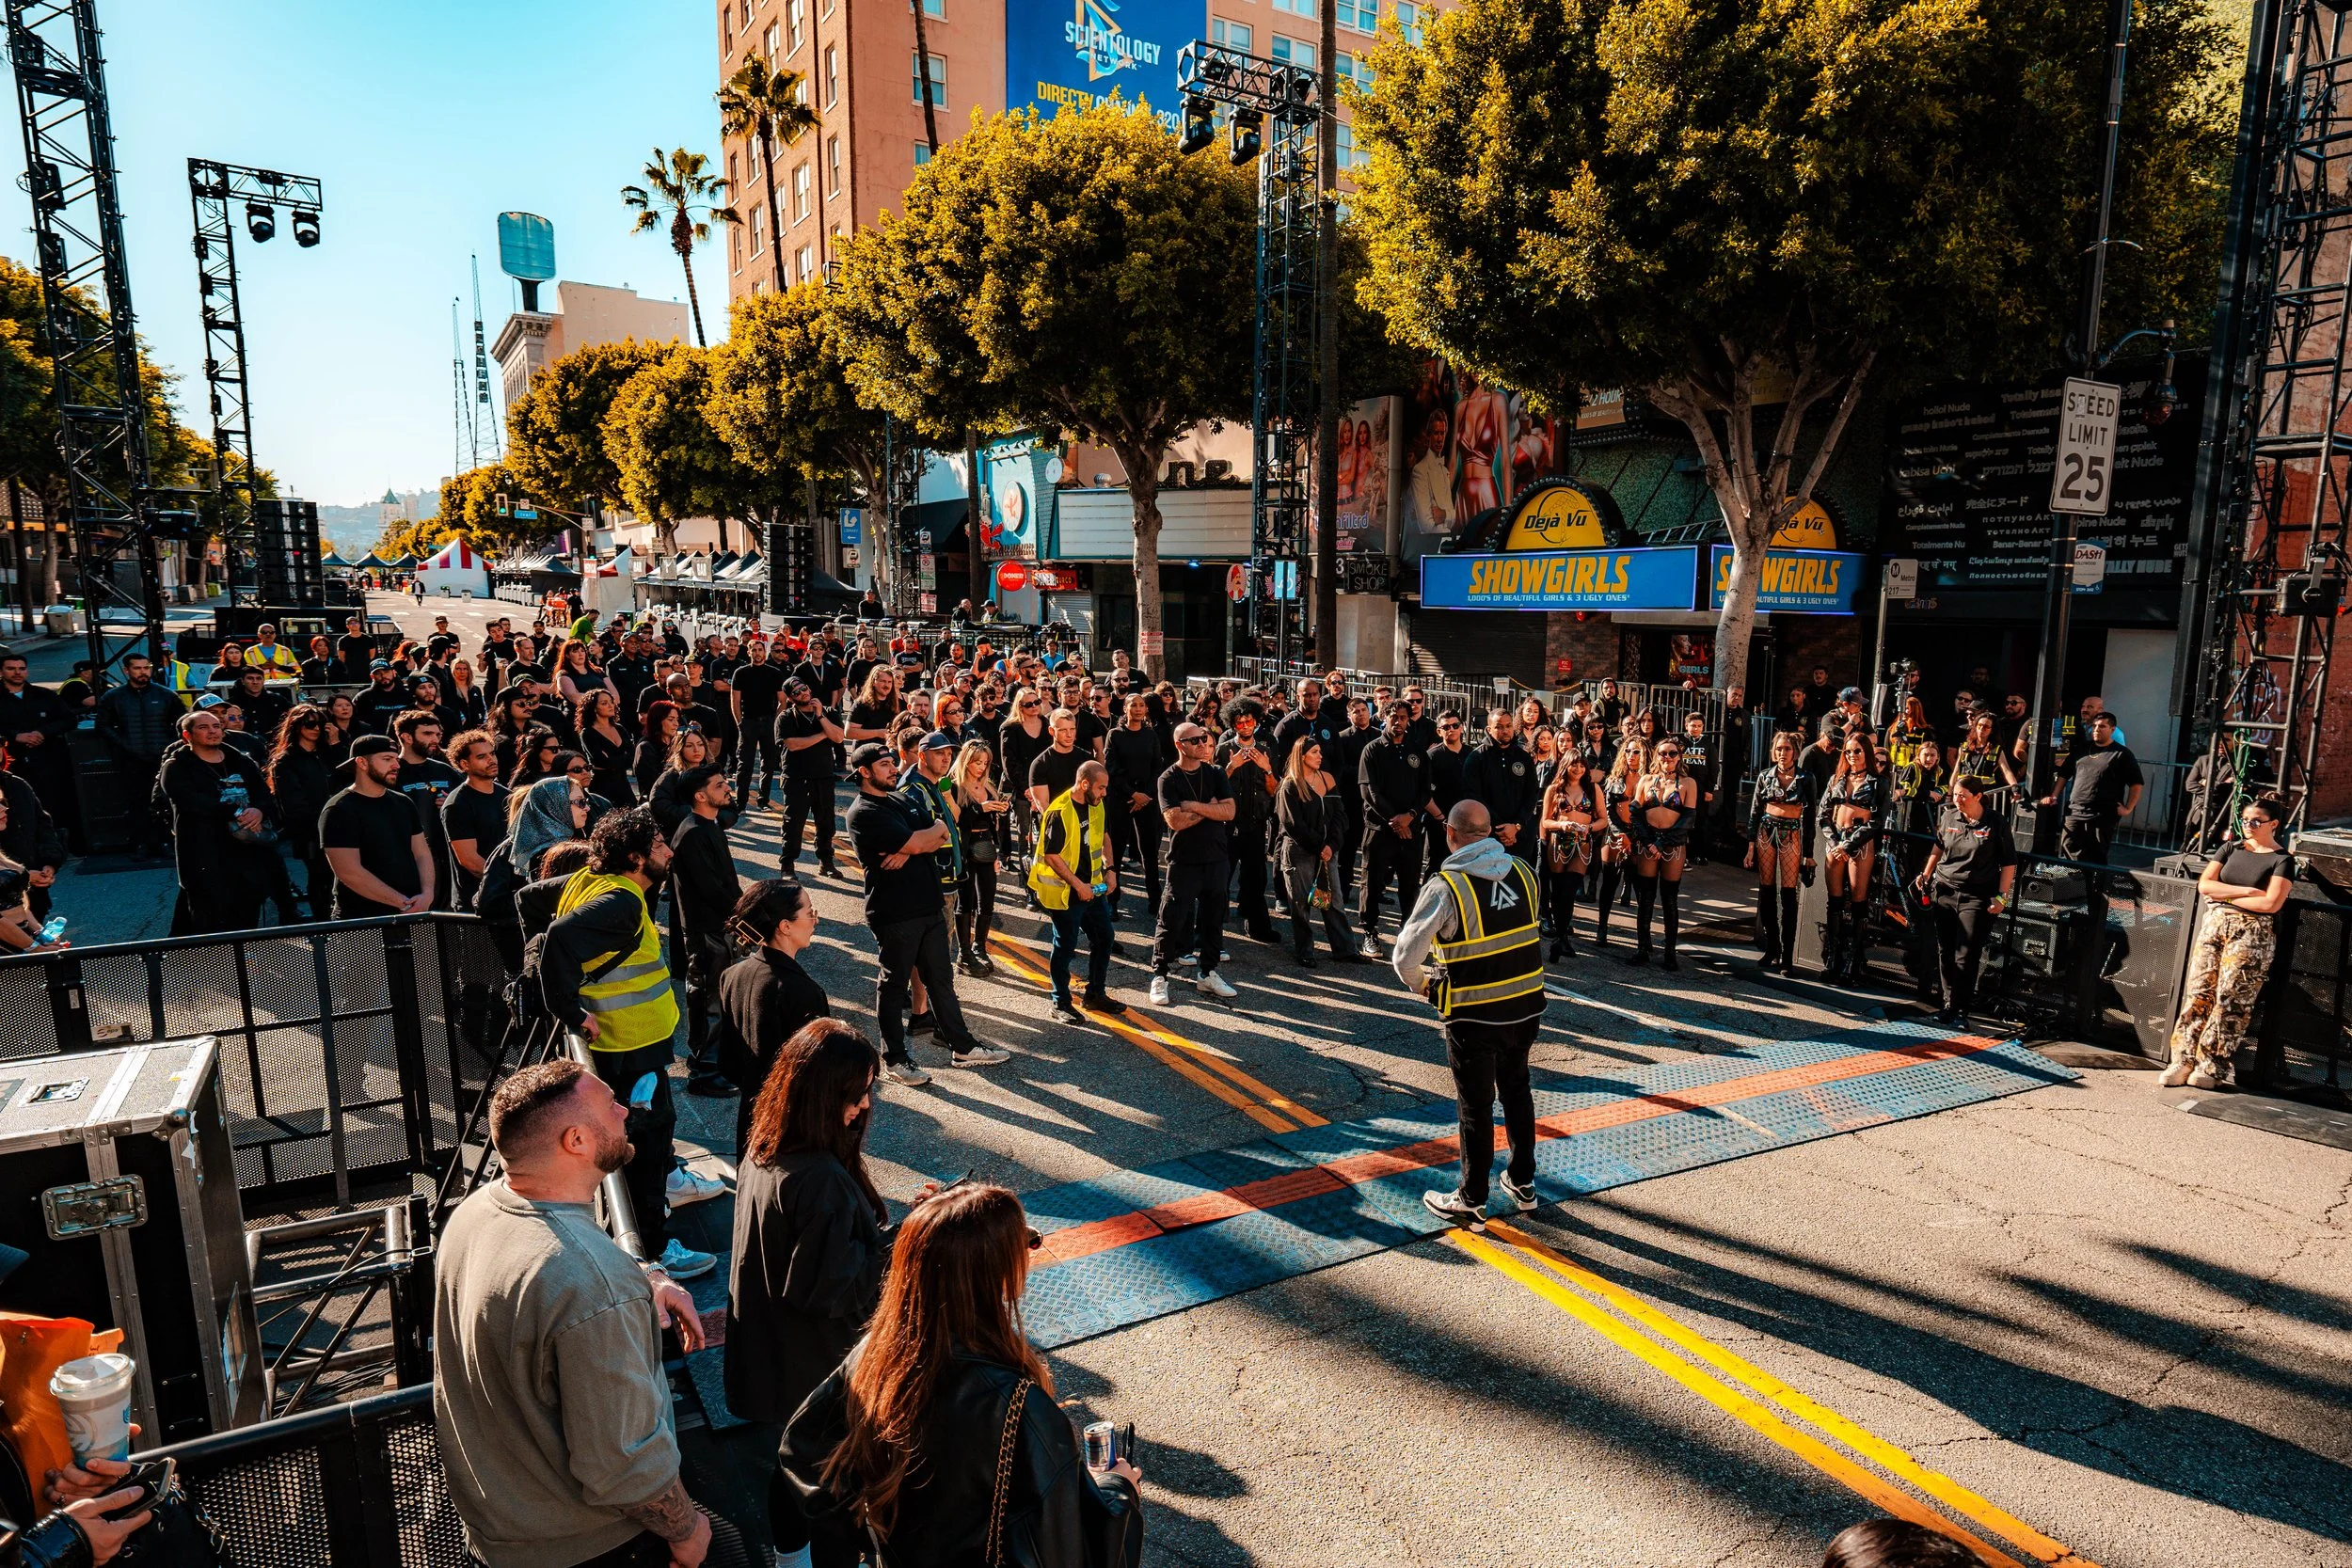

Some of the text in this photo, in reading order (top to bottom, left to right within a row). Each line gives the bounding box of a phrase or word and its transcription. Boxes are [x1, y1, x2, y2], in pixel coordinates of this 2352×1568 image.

[1065, 21, 1162, 66] SCIENTOLOGY
[1091, 53, 1137, 71] NETWORK
[1947, 402, 1971, 413] Nude
[2067, 391, 2115, 418] SEED
[2069, 423, 2108, 446] LIMIT
[2060, 452, 2106, 501] 25
[1565, 509, 1590, 528] Vu
[1804, 516, 1823, 531] Vu
[2098, 515, 2127, 527] Nude
[2075, 549, 2104, 560] DASH
[1349, 562, 1388, 577] SMOKE
[1468, 555, 1631, 594] SHOWGIRLS
[1716, 555, 1841, 594] SWGIRLS
[2136, 560, 2173, 574] NUDE
[1354, 576, 1385, 591] SHOP
[1900, 574, 1915, 582] Metro
[1503, 594, 1542, 602] BEAUTIFUL
[1543, 594, 1565, 602] GIRLS
[1566, 594, 1573, 602] &
[1575, 594, 1581, 602] 3
[1582, 594, 1604, 602] UGLY
[1889, 587, 1899, 595] 217
[1779, 595, 1796, 605] GIRLS
[1796, 596, 1802, 605] &
[1678, 665, 1709, 674] GIRLS
